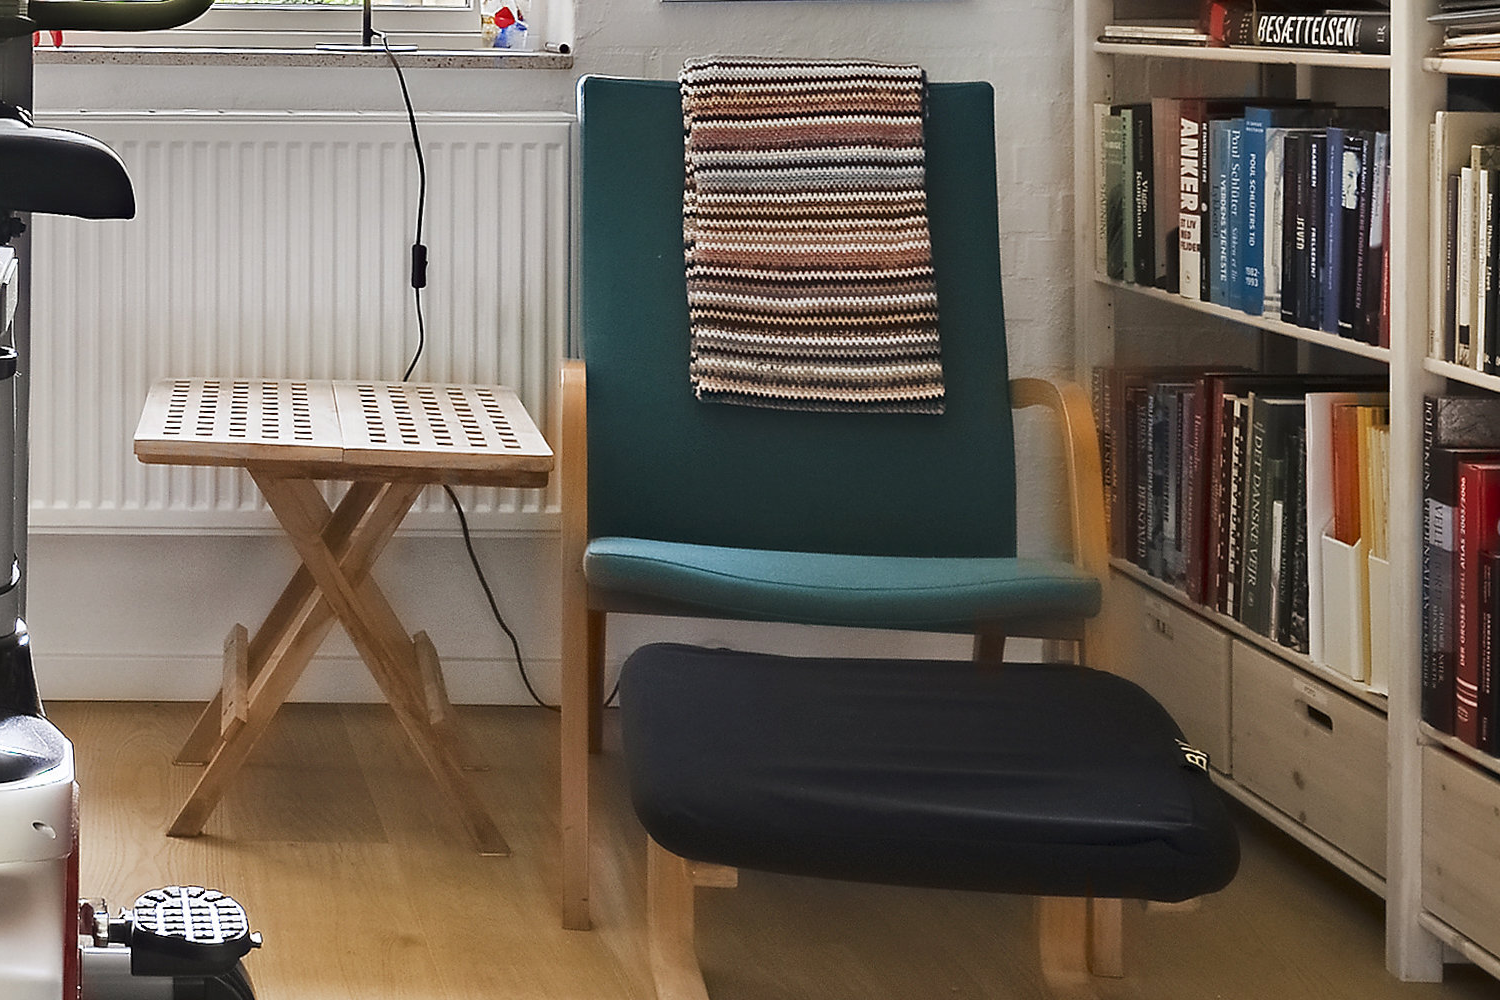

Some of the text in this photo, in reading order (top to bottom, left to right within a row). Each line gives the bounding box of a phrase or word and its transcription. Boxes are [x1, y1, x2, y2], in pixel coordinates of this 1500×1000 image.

[1257, 14, 1357, 45] BESÆTTELSEN
[1180, 118, 1199, 212] ANKER
[1231, 130, 1240, 160] Poul
[1231, 163, 1240, 216] Schlüter
[1249, 179, 1257, 230] SCHLÜTERS
[1423, 401, 1433, 492] POLITIKENS
[1247, 435, 1263, 587] DET DANSKE VEJR
[1433, 504, 1444, 547] VEJLE
